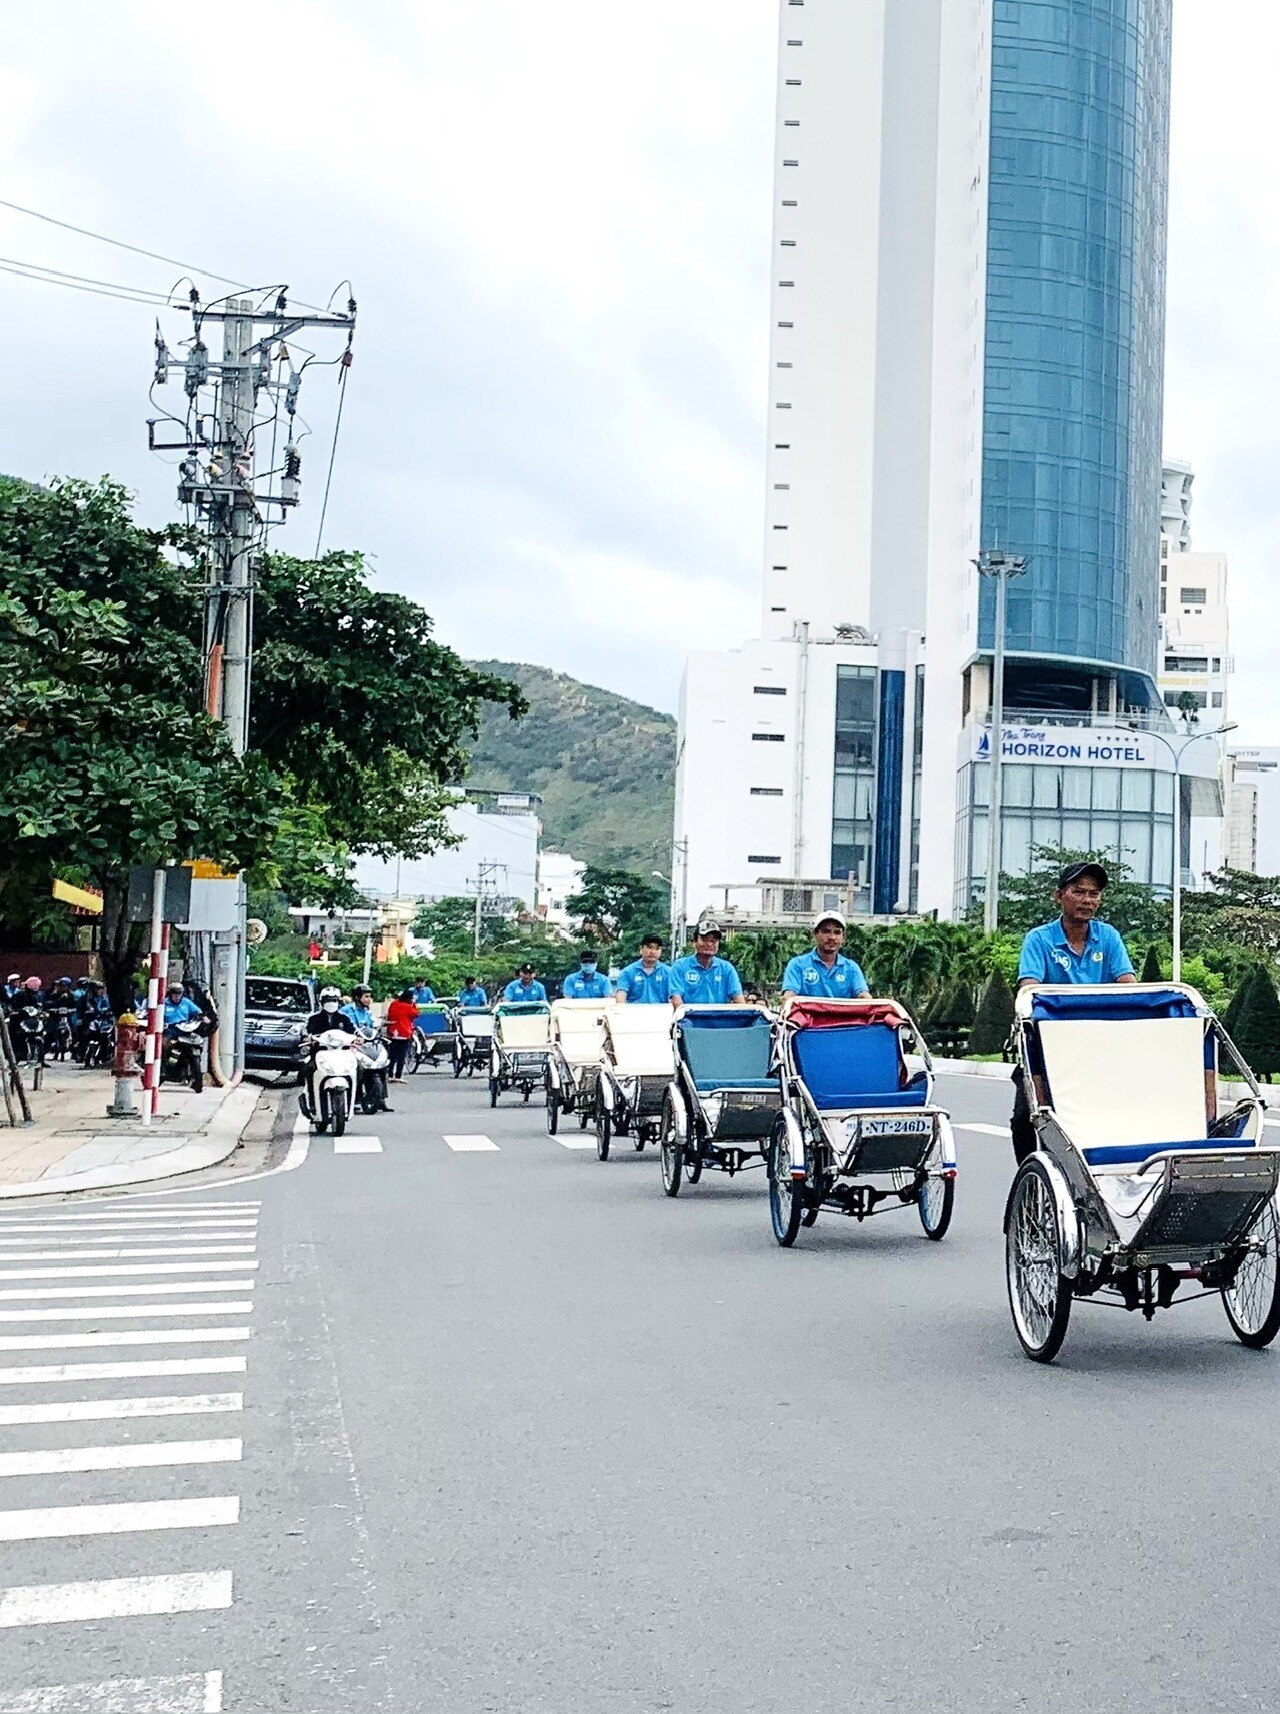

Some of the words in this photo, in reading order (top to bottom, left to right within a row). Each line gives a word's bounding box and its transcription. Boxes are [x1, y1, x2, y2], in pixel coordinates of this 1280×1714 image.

[1001, 728, 1019, 741] Nha
[1020, 727, 1046, 741] Trang
[1001, 742, 1081, 758] HORIZON
[1088, 746, 1146, 761] HOTEL
